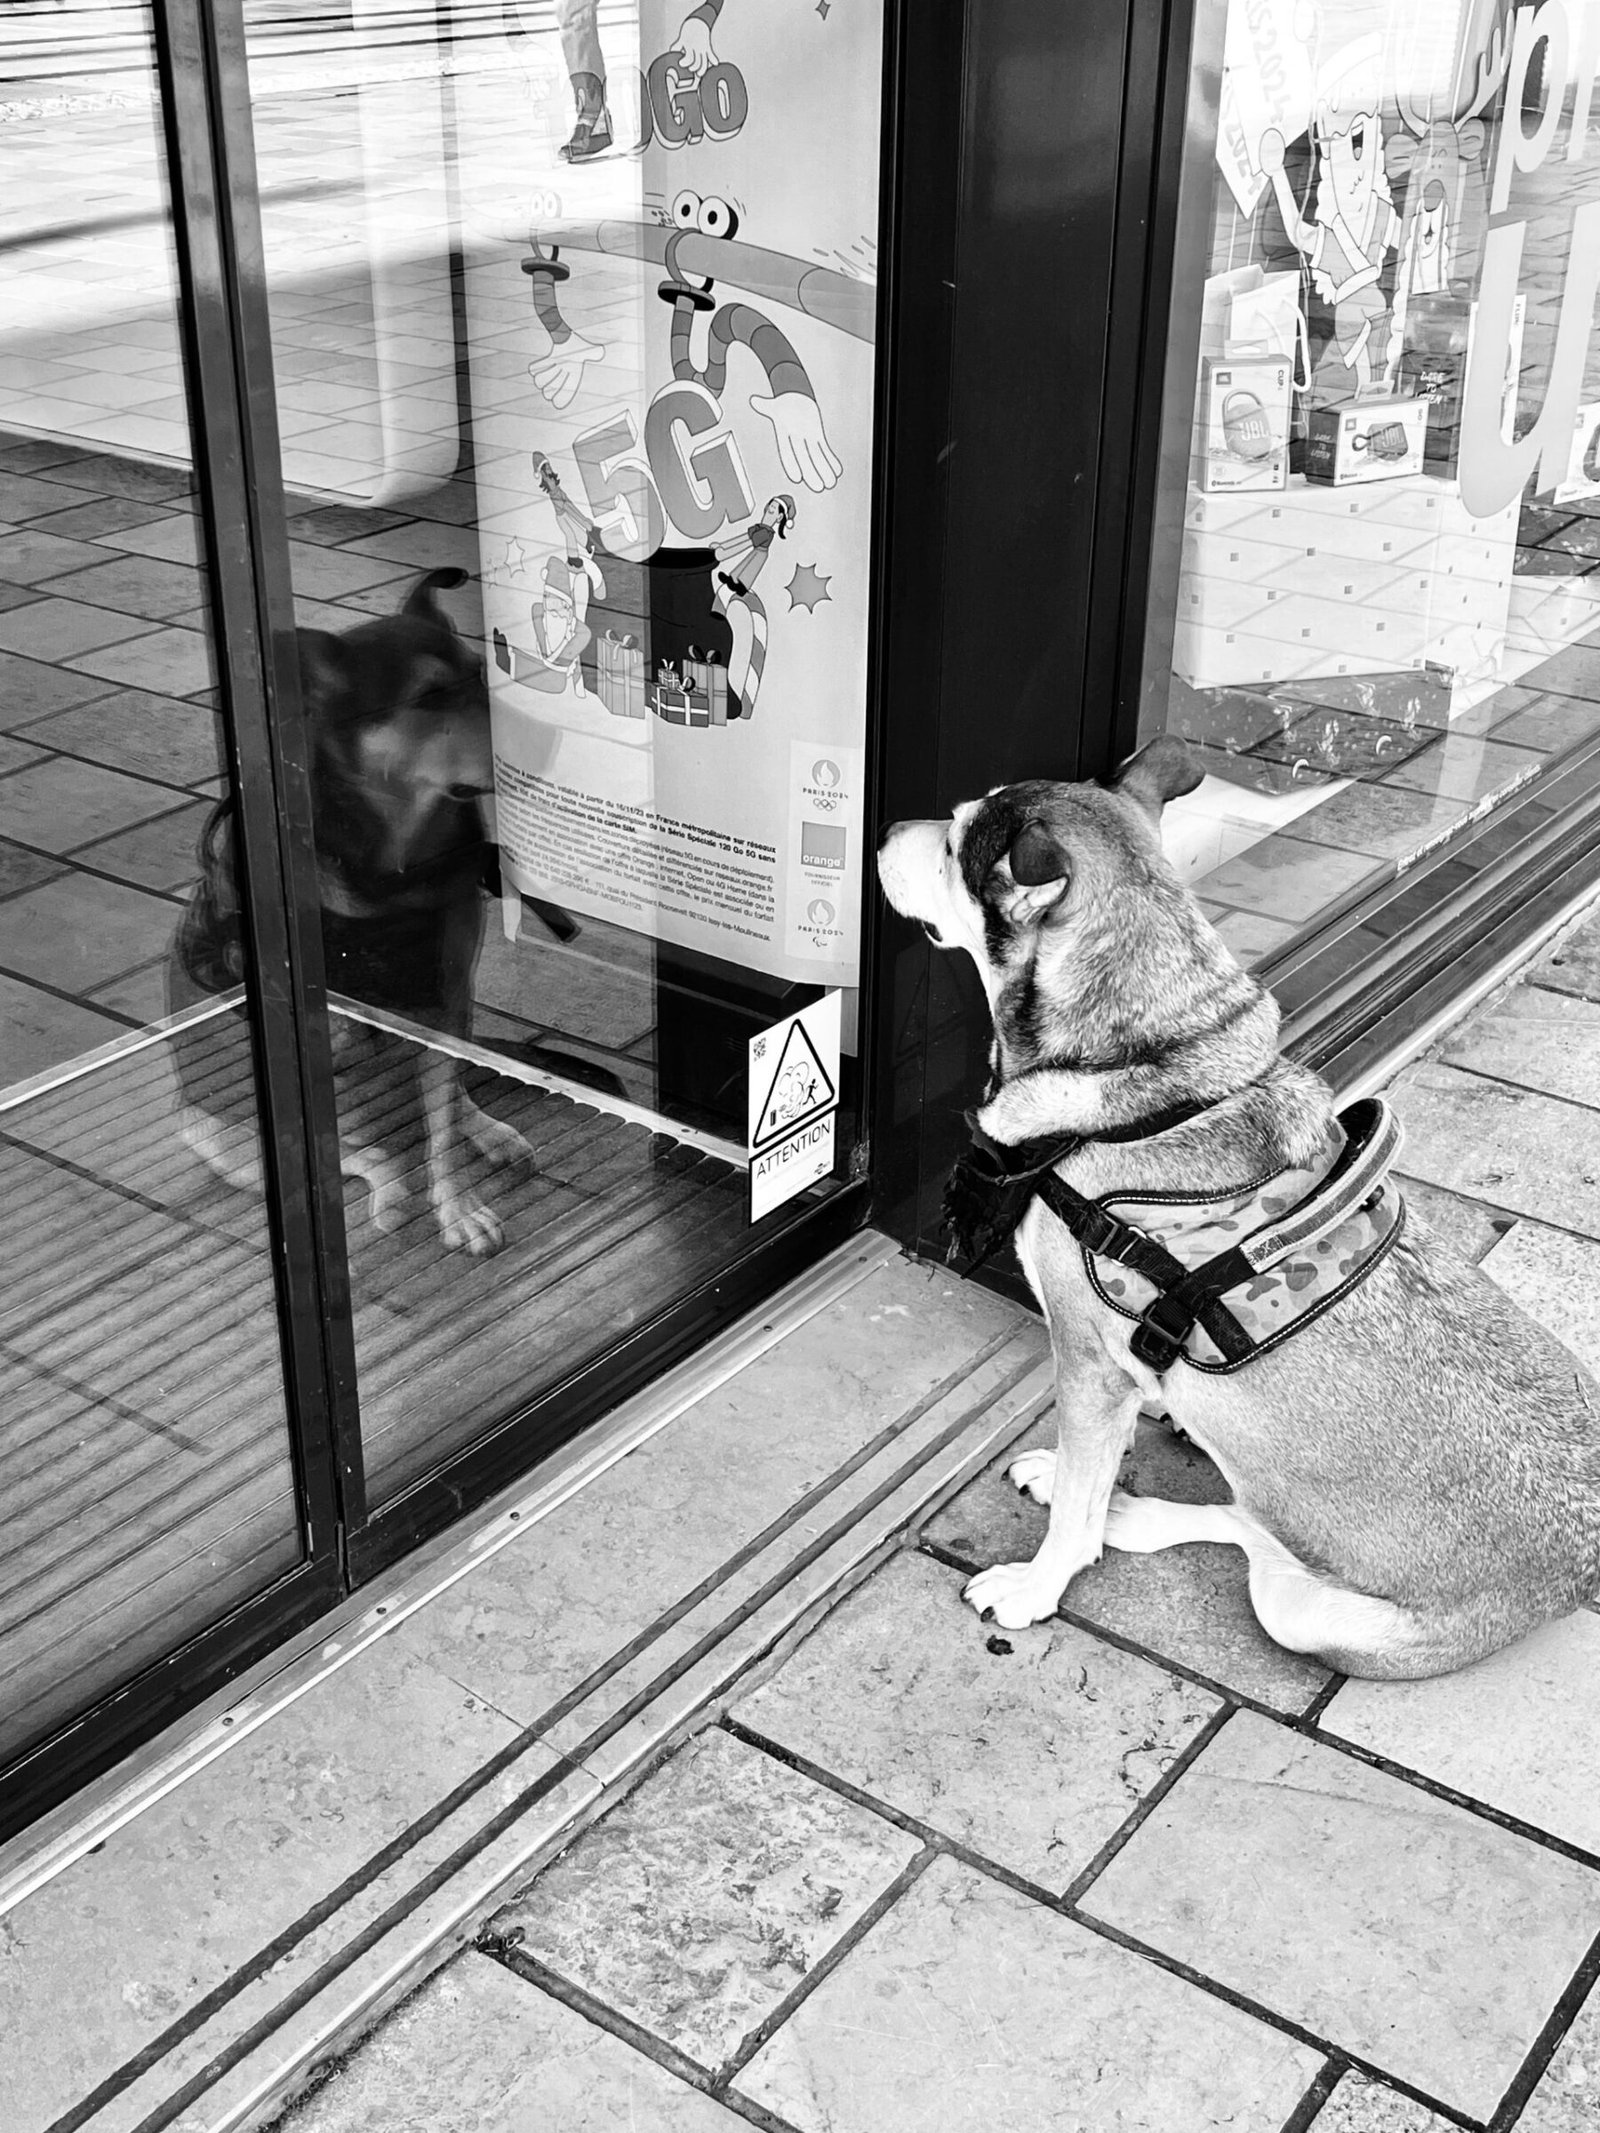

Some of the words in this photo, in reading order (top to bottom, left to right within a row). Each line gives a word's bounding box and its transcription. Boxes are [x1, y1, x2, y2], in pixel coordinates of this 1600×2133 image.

[1426, 383, 1437, 393] TO
[1240, 419, 1270, 441] JBL
[1381, 428, 1404, 448] JBL
[572, 378, 756, 564] 5G
[802, 787, 824, 796] PARIS
[828, 791, 848, 799] 2024
[561, 795, 576, 805] toute
[578, 802, 604, 814] nouvelle
[606, 810, 646, 826] souscription
[668, 827, 685, 838] Série
[687, 832, 716, 847] Spéciale
[719, 842, 730, 851] 120
[733, 845, 743, 854] Go
[745, 849, 755, 858] 5G
[758, 854, 775, 863] sans
[586, 795, 603, 804] partir
[656, 814, 679, 826] France
[681, 822, 730, 841] métropolitaine
[746, 841, 776, 853] réseaux
[604, 819, 620, 828] carte
[702, 858, 719, 868] cours
[803, 854, 840, 868] orange
[686, 871, 704, 882] Open
[727, 884, 746, 895] Home
[701, 896, 713, 904] prix
[754, 911, 773, 922] forfait
[798, 924, 820, 934] PARIS
[756, 1119, 830, 1179] ATTENTION
